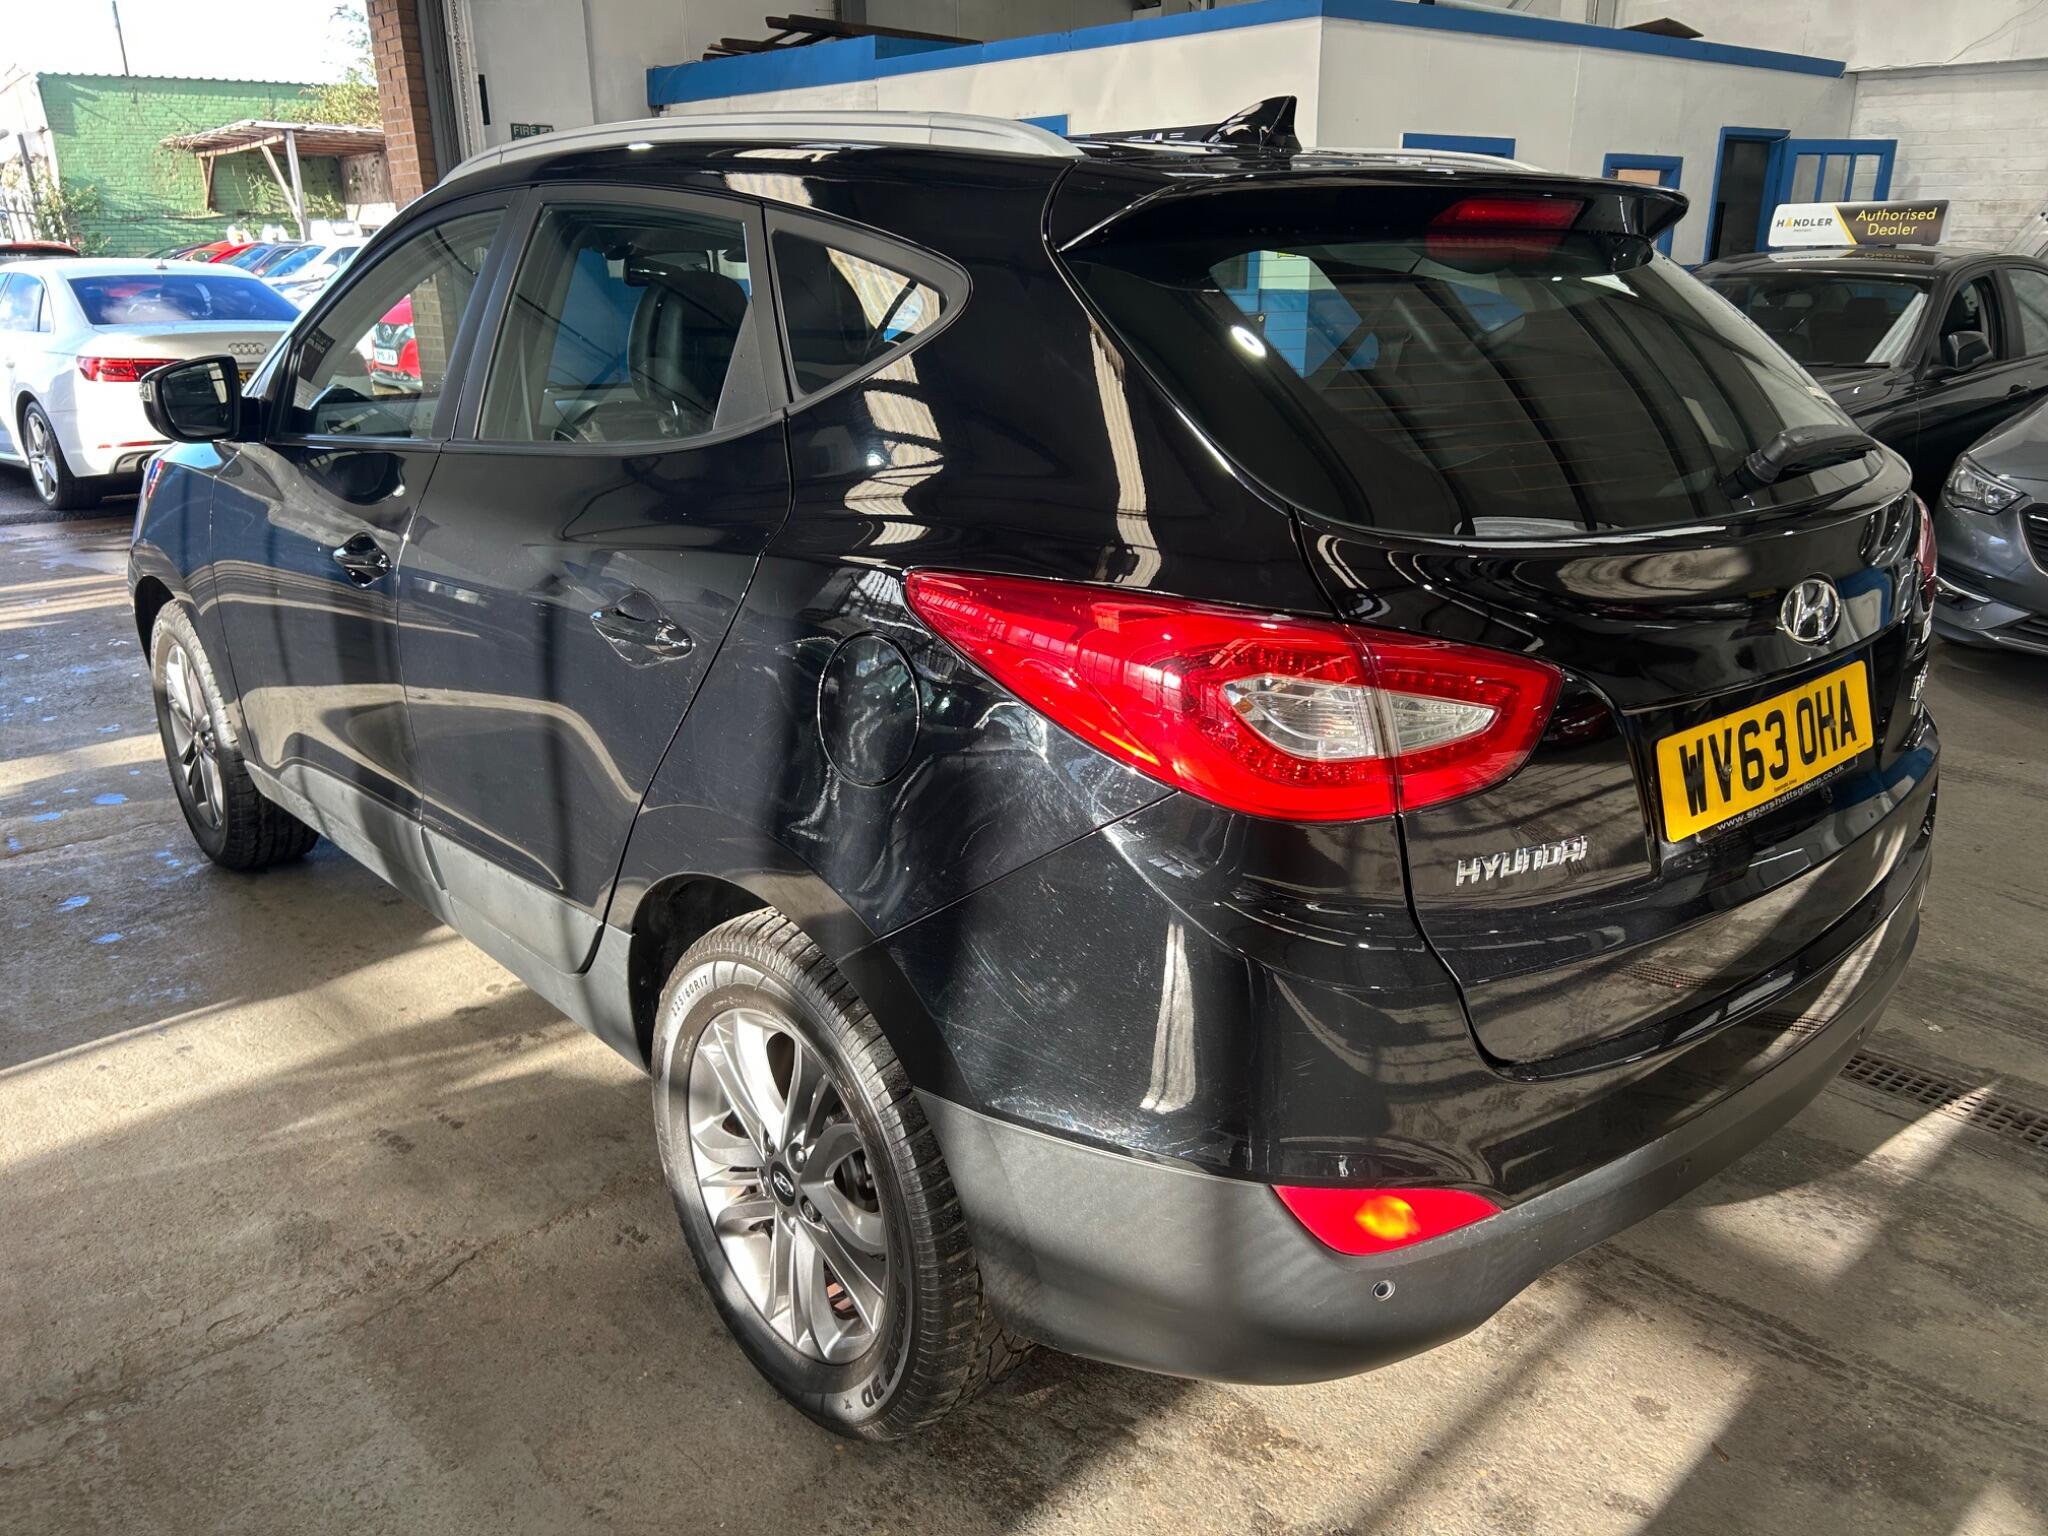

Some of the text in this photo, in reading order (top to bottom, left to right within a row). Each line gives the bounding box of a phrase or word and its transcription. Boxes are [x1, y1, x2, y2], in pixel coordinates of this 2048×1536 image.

[513, 125, 537, 136] FIRE
[1855, 207, 1938, 222] Authorised
[1867, 222, 1918, 237] Dealer
[1679, 709, 1790, 817] WV63
[1796, 680, 1858, 766] OHA
[1456, 835, 1588, 887] HYUNDAI
